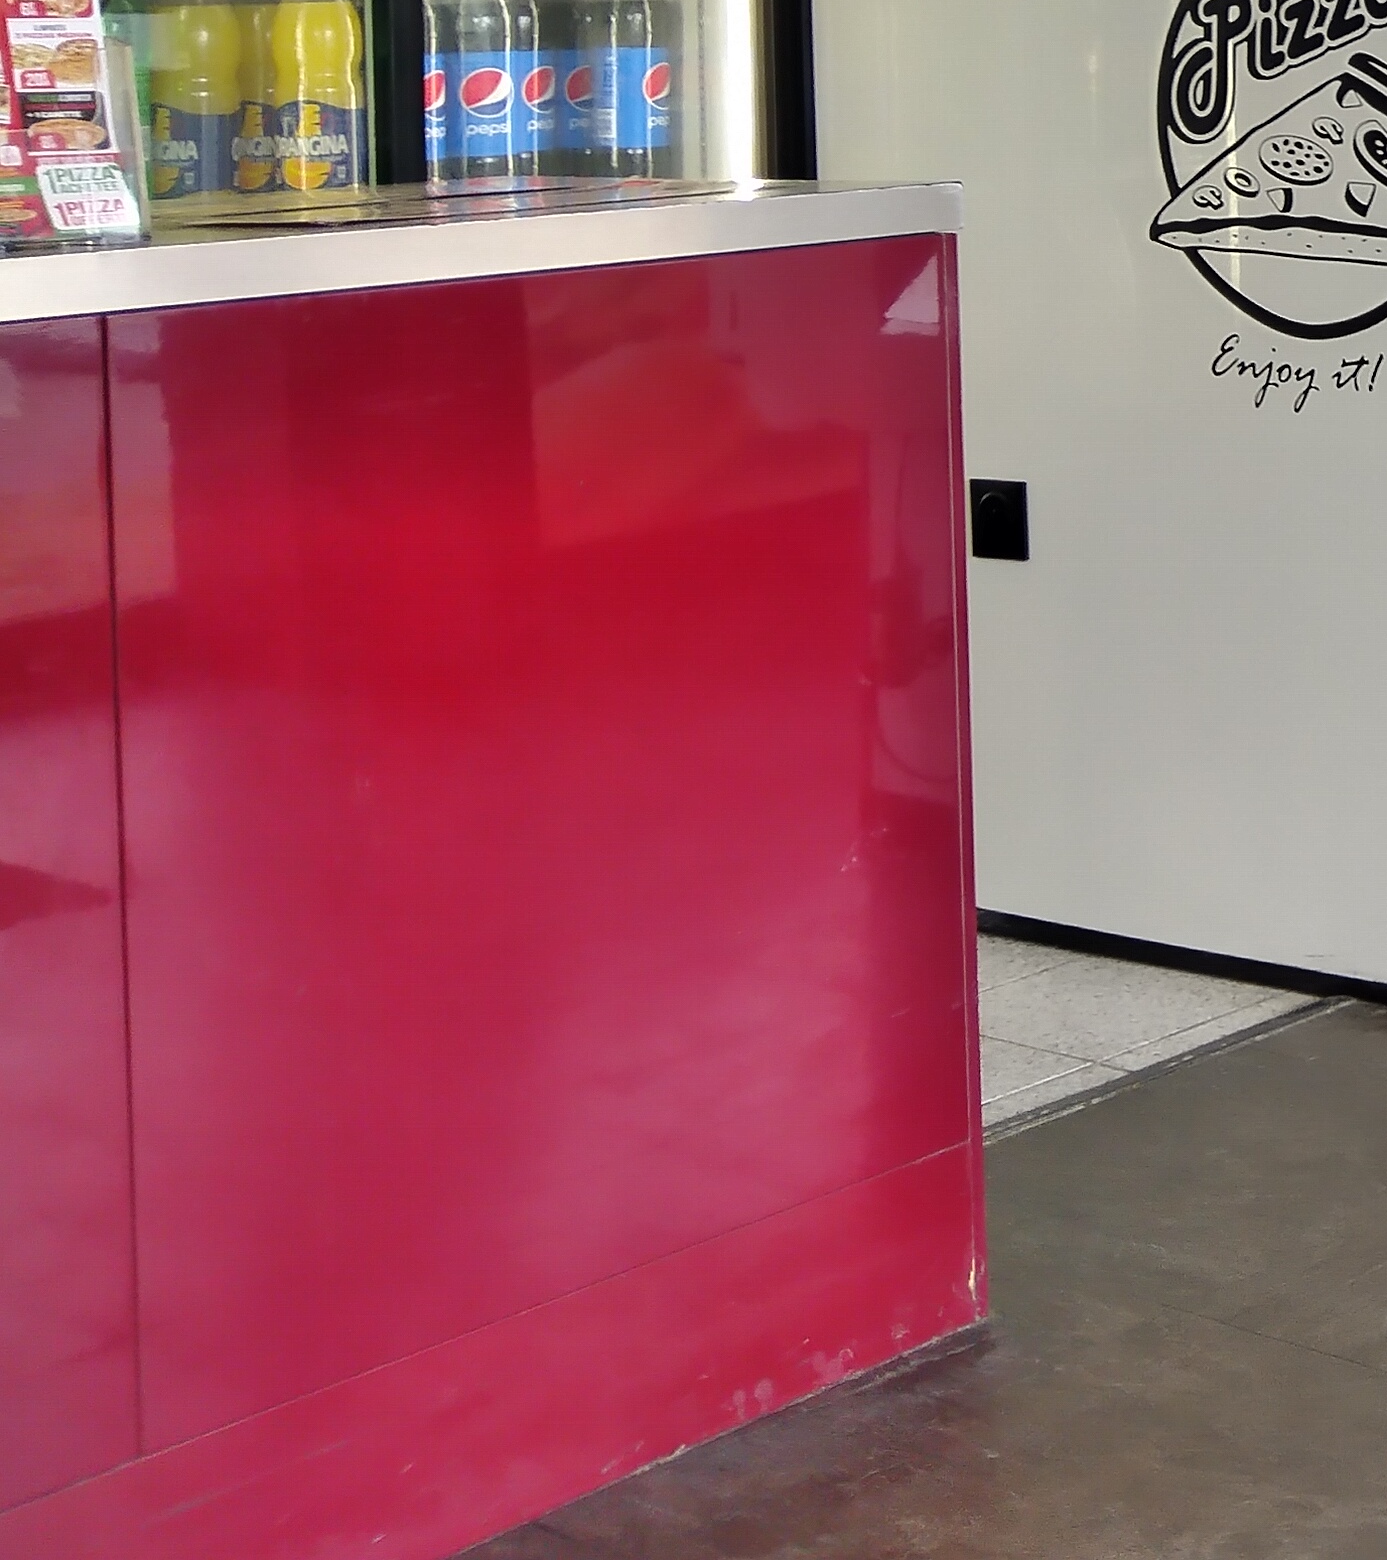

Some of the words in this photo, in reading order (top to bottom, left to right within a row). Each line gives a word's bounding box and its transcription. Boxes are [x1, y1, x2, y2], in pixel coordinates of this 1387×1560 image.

[55, 166, 116, 182] PIZZA
[67, 198, 125, 215] PIZZA
[1211, 333, 1320, 413] Enjoy
[1332, 353, 1384, 391] it!
